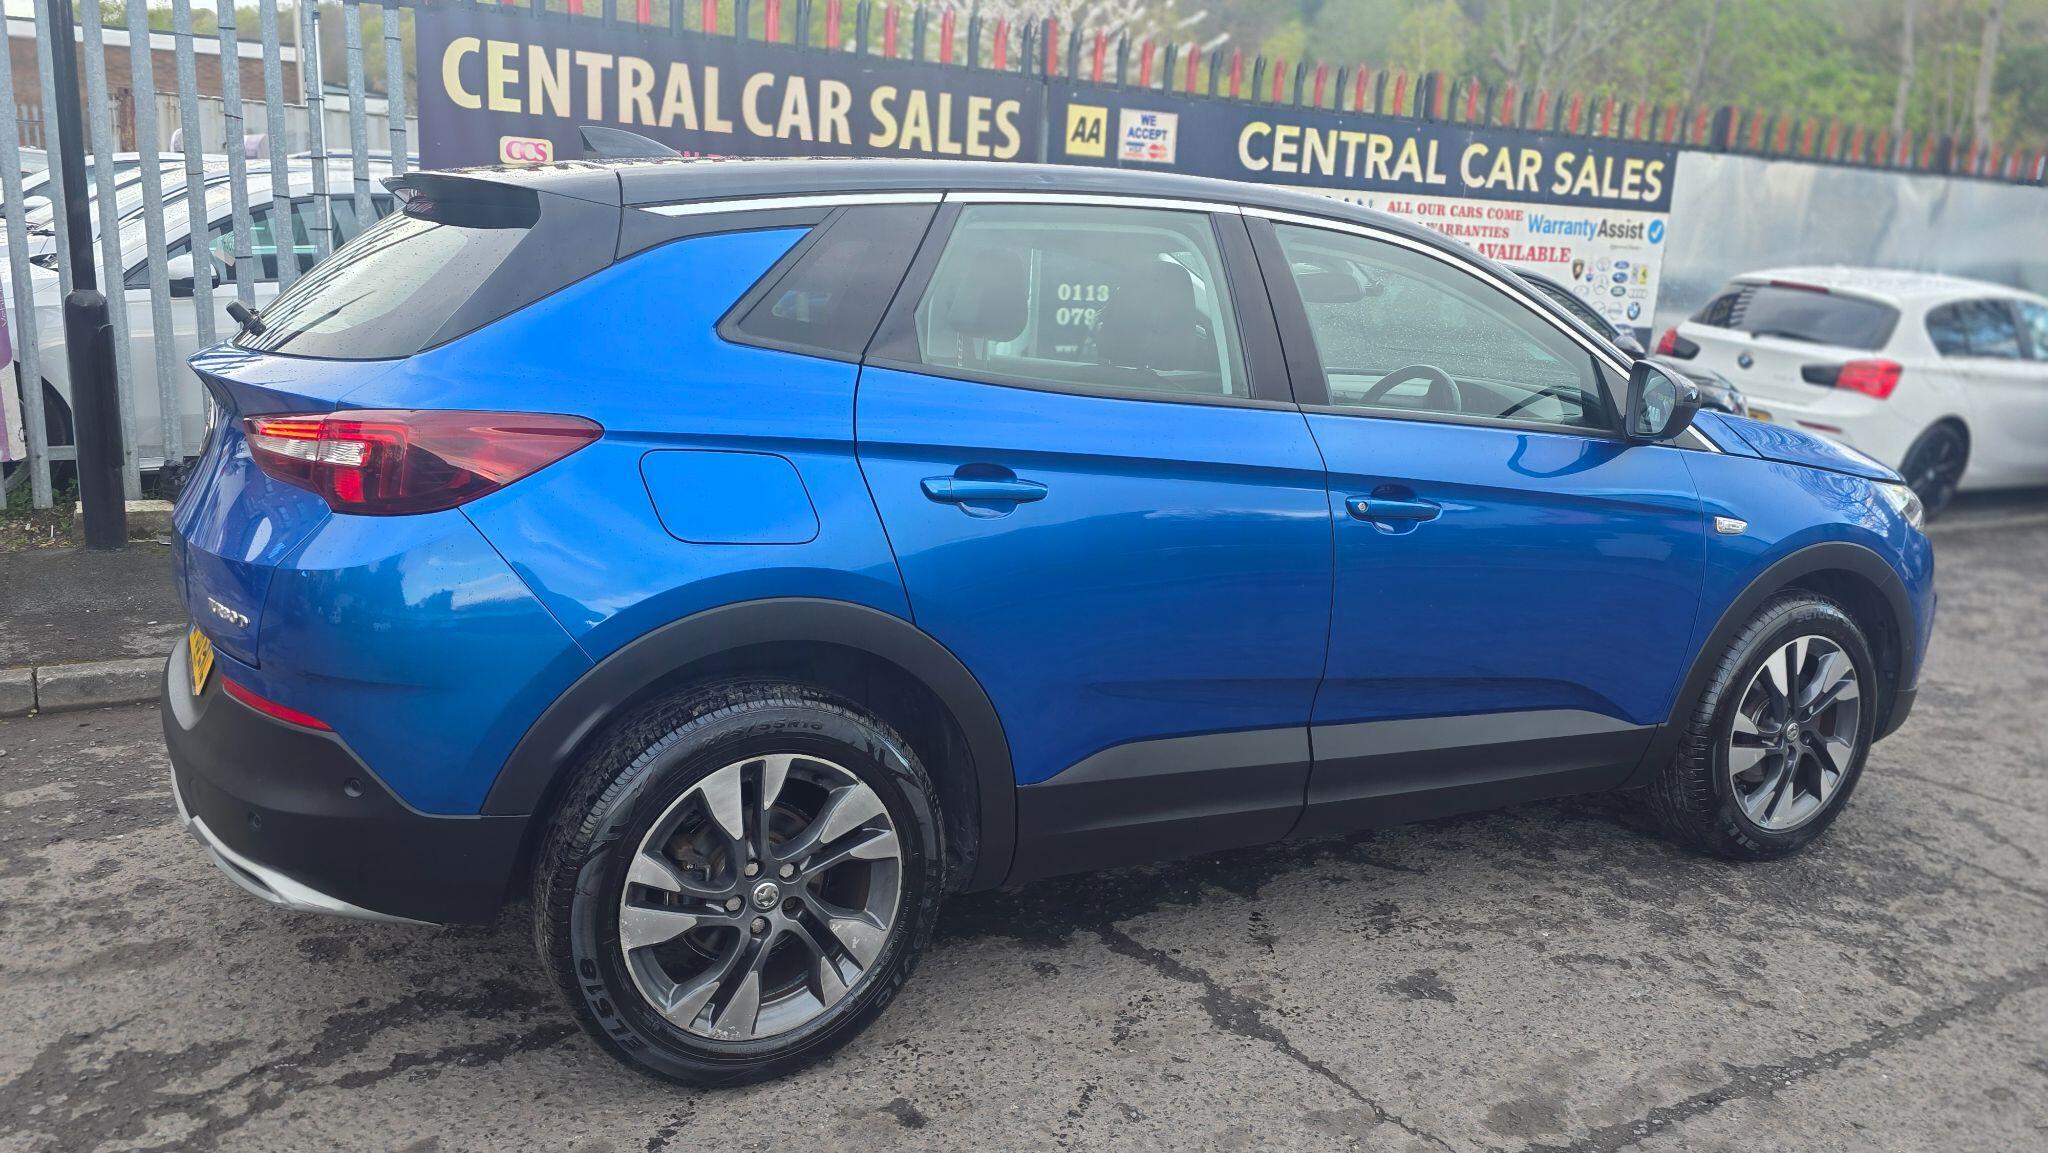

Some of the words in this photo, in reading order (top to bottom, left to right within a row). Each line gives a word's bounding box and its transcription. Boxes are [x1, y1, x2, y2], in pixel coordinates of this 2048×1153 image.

[442, 36, 733, 134] CENTRAL
[741, 72, 853, 145] CAR
[868, 85, 1021, 160] SALES
[1070, 116, 1103, 144] AA
[1141, 114, 1157, 126] WE
[1127, 126, 1168, 141] ACCEPT
[1238, 121, 1447, 186] CENTRAL
[1460, 143, 1543, 193] CAR
[1551, 151, 1665, 202] SALES
[1387, 200, 1413, 214] ALL
[1417, 202, 1446, 217] OUR
[1450, 204, 1483, 219] CARS
[1487, 207, 1524, 221] COME
[1057, 283, 1110, 302] 0113
